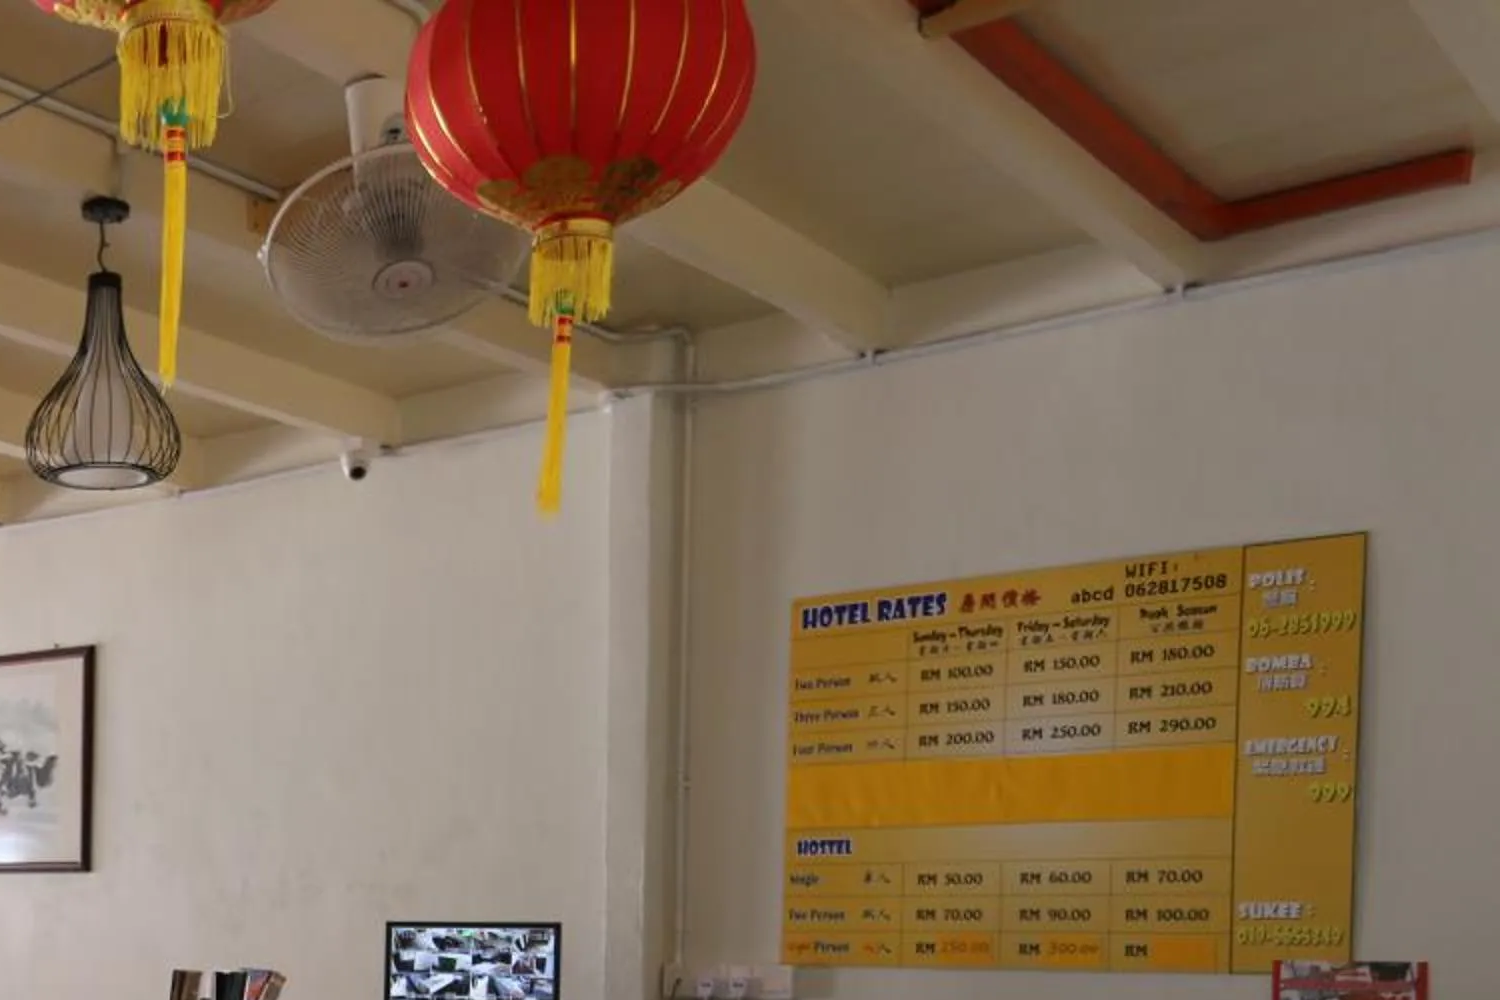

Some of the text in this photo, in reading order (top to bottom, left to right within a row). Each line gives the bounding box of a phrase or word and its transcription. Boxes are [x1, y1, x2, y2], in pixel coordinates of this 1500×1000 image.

[1070, 573, 1228, 604] abcd 062817508
[802, 592, 947, 629] HOTEL RATES
[1017, 621, 1050, 634] Friday
[1063, 615, 1111, 630] Saturday
[913, 629, 947, 643] Sunday
[958, 624, 1004, 638] Thursday
[1024, 655, 1100, 673] RM 150.00
[1131, 650, 1153, 664] RM
[1245, 653, 1313, 674] BOMBA
[920, 664, 994, 682] RM 100.00
[1129, 681, 1213, 699] RM 210.00
[1023, 694, 1044, 707] RM
[919, 702, 940, 715] RM
[1022, 724, 1101, 741] RM 250.00
[1128, 717, 1216, 734] RM 290.00
[918, 731, 994, 747] RM 200.00
[797, 839, 852, 855] HOSTEL
[917, 873, 937, 885] RM
[1020, 871, 1092, 885] RM 60.00
[1126, 869, 1203, 884] RM 70.00
[916, 909, 983, 922] RM 70.00
[1019, 908, 1091, 922] RM 90.00
[1125, 908, 1209, 922] RM 100.00
[916, 942, 936, 954] RM
[1019, 943, 1041, 956] RM
[1125, 944, 1148, 957] RM
